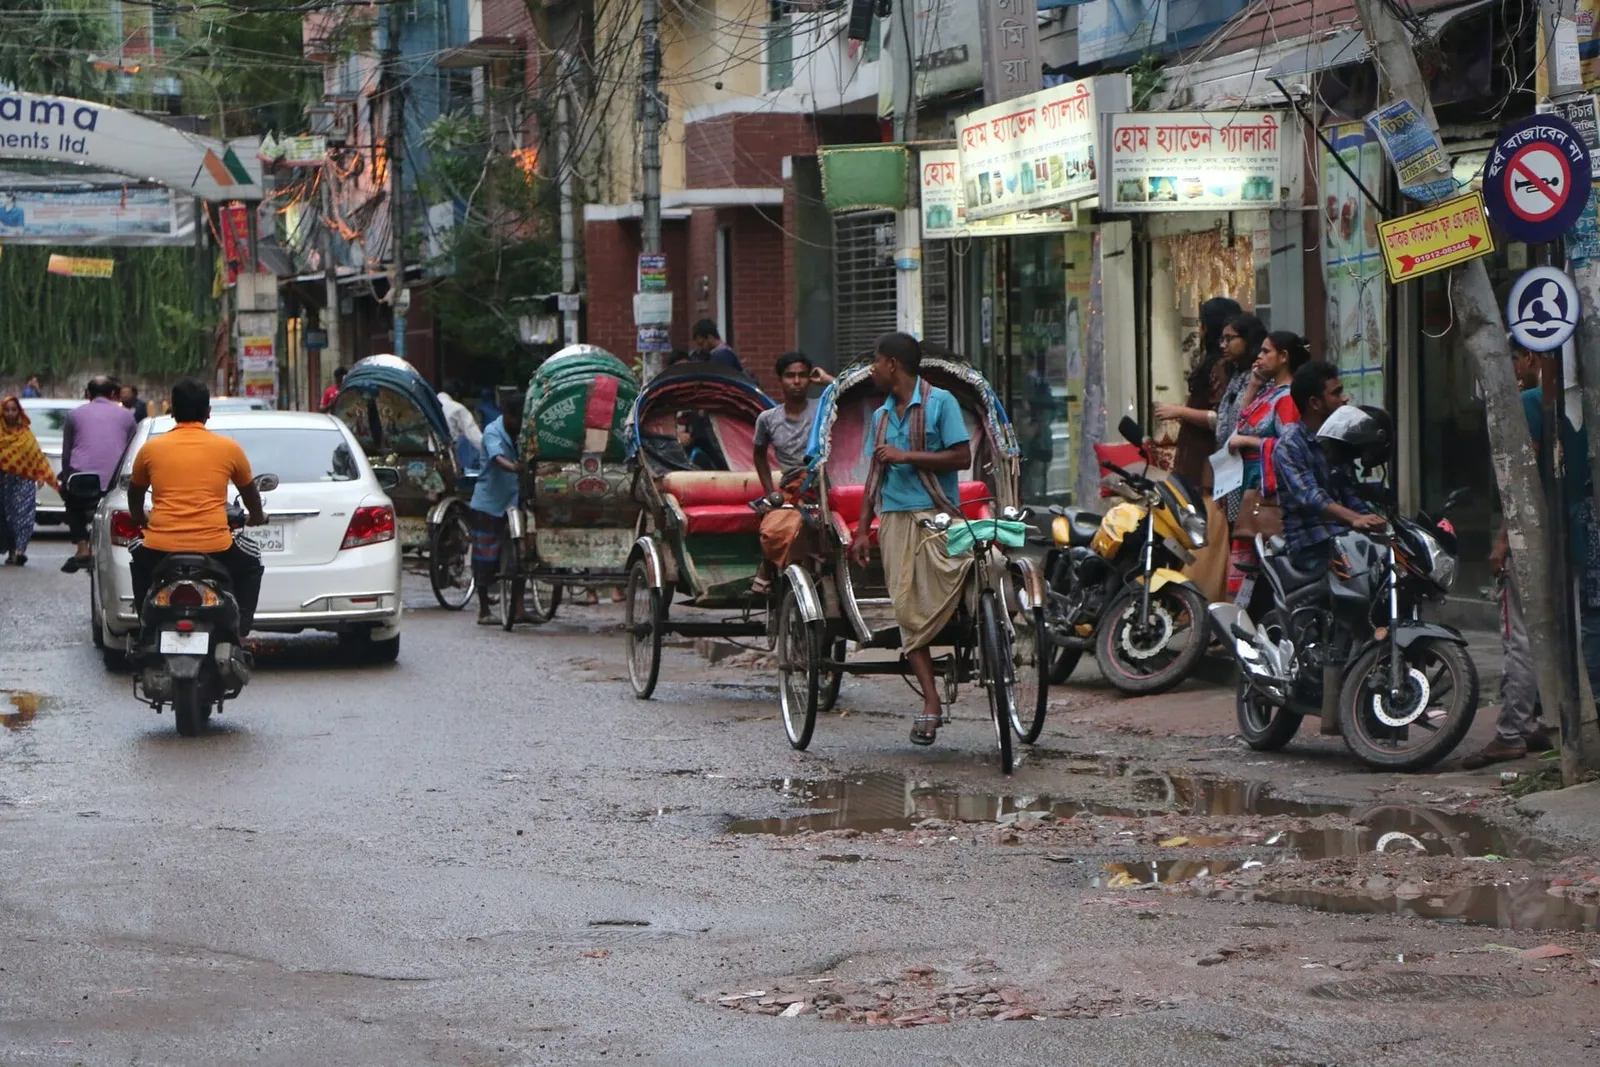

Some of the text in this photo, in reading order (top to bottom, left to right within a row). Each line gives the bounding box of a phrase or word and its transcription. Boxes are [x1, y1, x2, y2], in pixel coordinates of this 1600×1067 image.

[0, 97, 98, 132] ama
[962, 121, 988, 152] হোম
[991, 108, 1037, 142] হ্যাভেন
[1041, 83, 1091, 129] গ্যালারী
[1567, 103, 1593, 121] টিচার
[59, 133, 89, 155] ltd.
[1113, 125, 1150, 153] হোম
[1155, 125, 1213, 153] হ্যাভেন
[1220, 114, 1279, 153] গ্যালারী
[1503, 125, 1569, 149] বাজাবেন
[1569, 140, 1584, 162] না
[923, 161, 956, 187] হোম
